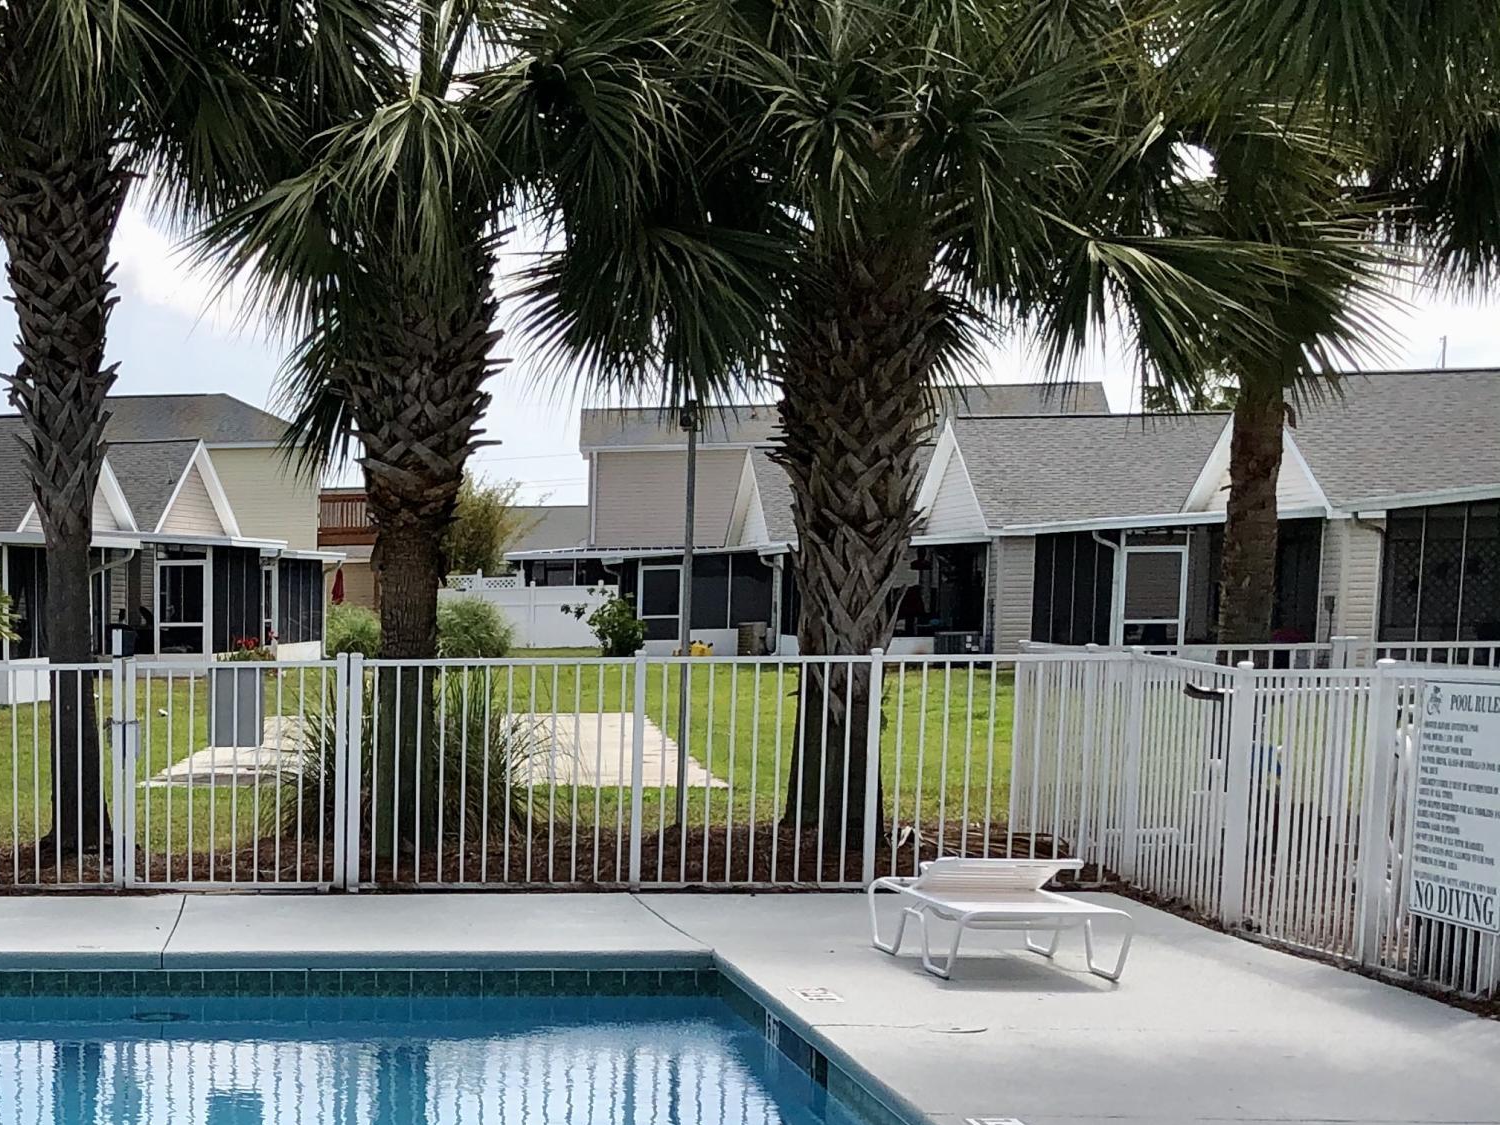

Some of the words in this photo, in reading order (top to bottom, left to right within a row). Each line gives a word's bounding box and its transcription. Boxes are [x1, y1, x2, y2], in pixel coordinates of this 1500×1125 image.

[1450, 694, 1473, 712] POOL
[1415, 880, 1434, 911] NO
[1437, 885, 1494, 926] DIVING
